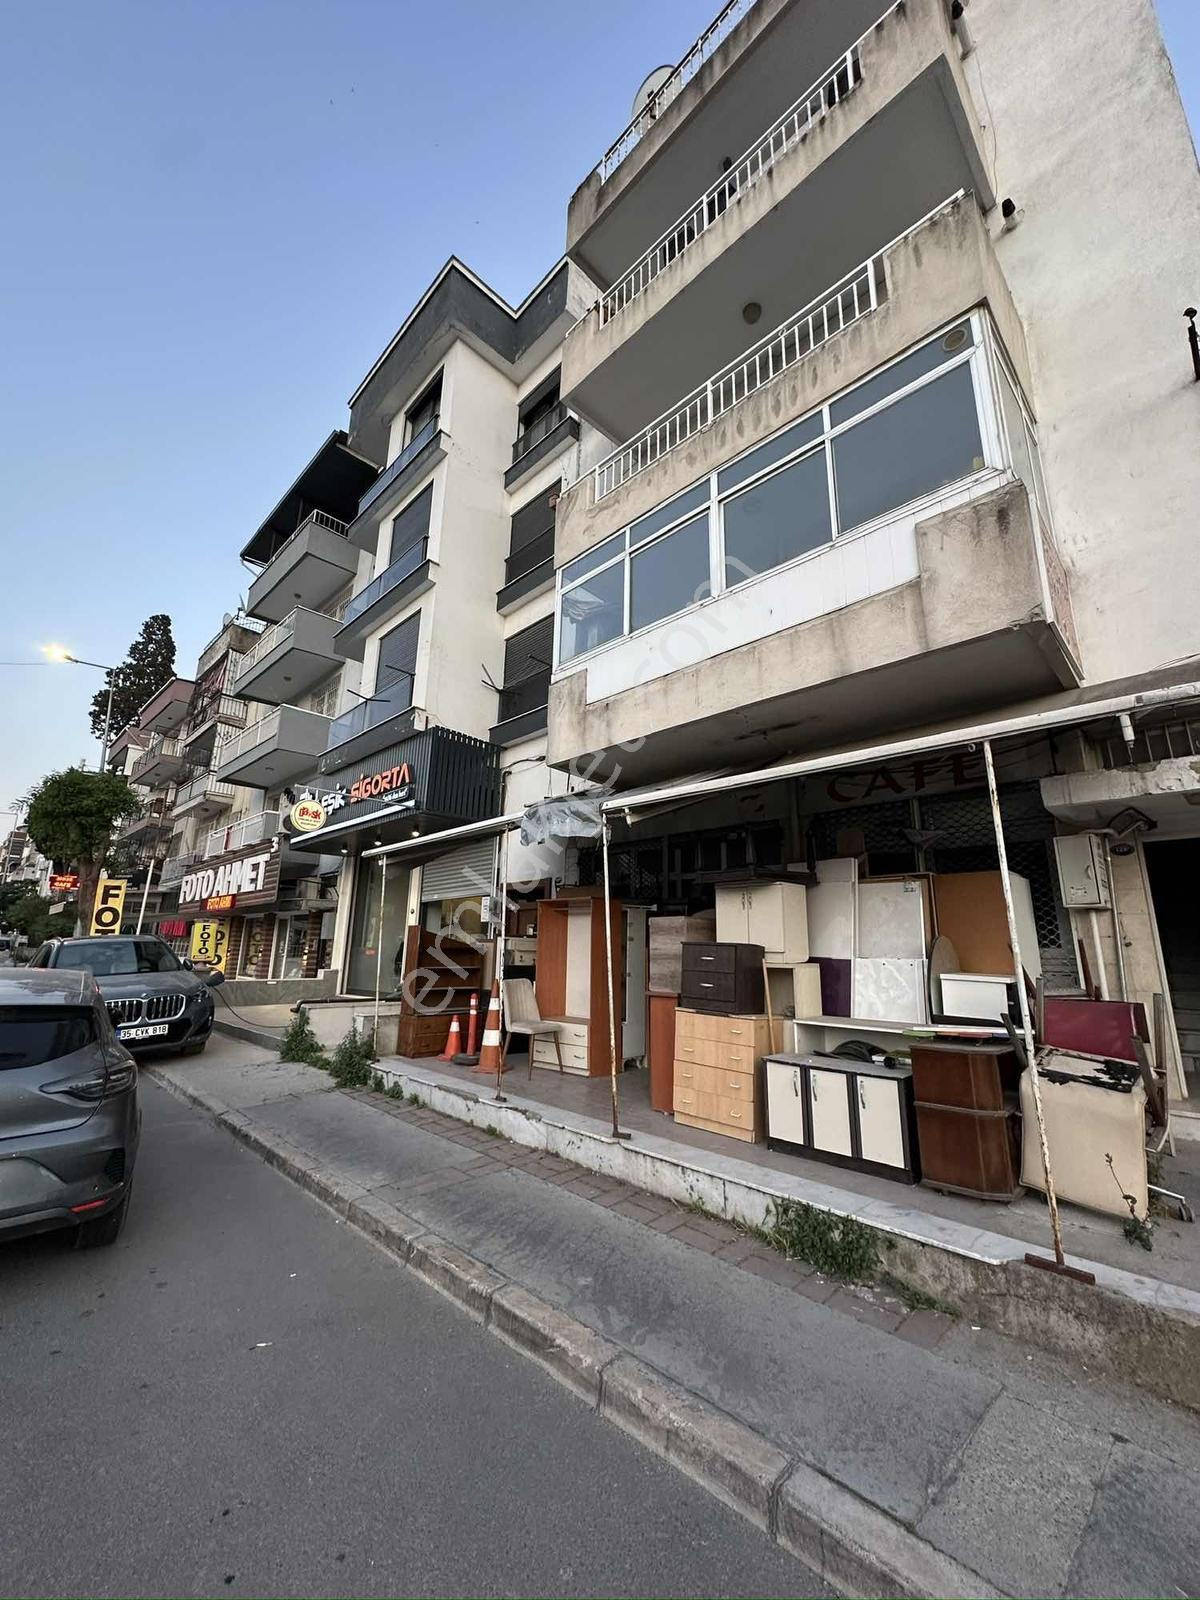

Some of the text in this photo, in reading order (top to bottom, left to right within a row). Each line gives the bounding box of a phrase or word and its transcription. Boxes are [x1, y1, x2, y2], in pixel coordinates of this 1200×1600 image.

[826, 752, 985, 802] CAFE
[179, 853, 271, 904] FOTO AHMET
[94, 884, 122, 936] FO
[197, 924, 211, 955] FOTO
[121, 1025, 167, 1038] 35 CVK 818
